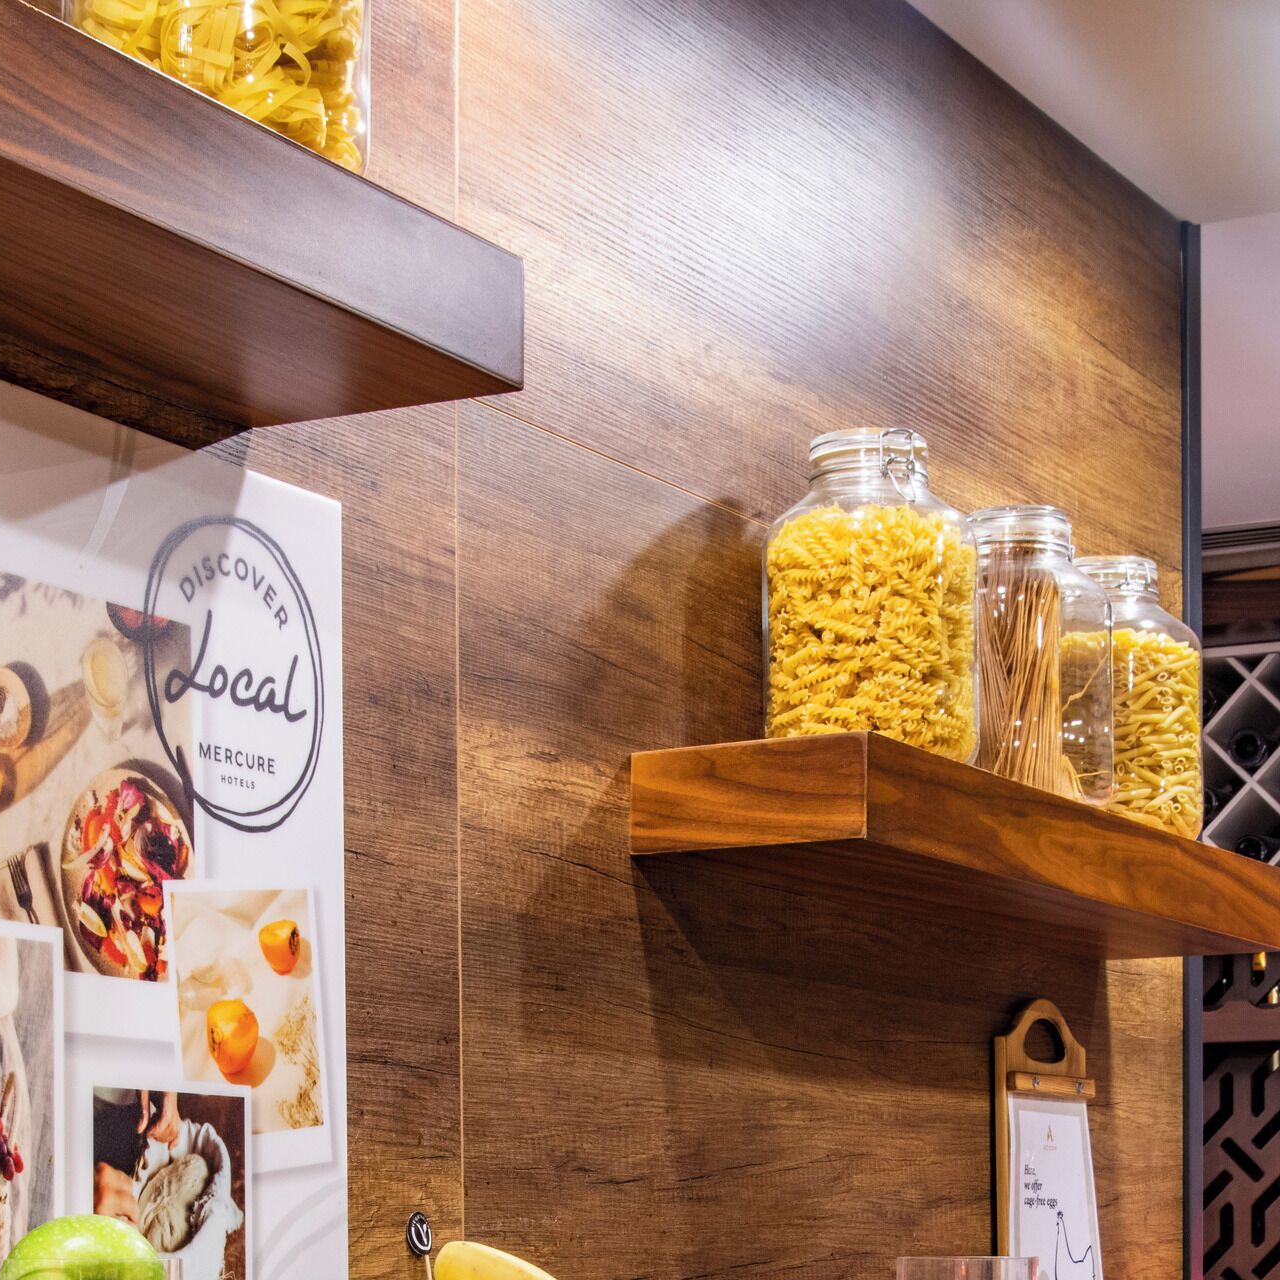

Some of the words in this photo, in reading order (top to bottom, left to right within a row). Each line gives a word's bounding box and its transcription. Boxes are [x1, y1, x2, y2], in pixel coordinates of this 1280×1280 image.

[179, 553, 288, 630] DISCOVER
[164, 609, 307, 723] Local
[198, 742, 277, 775] MERCURE
[220, 774, 256, 791] HOTELS
